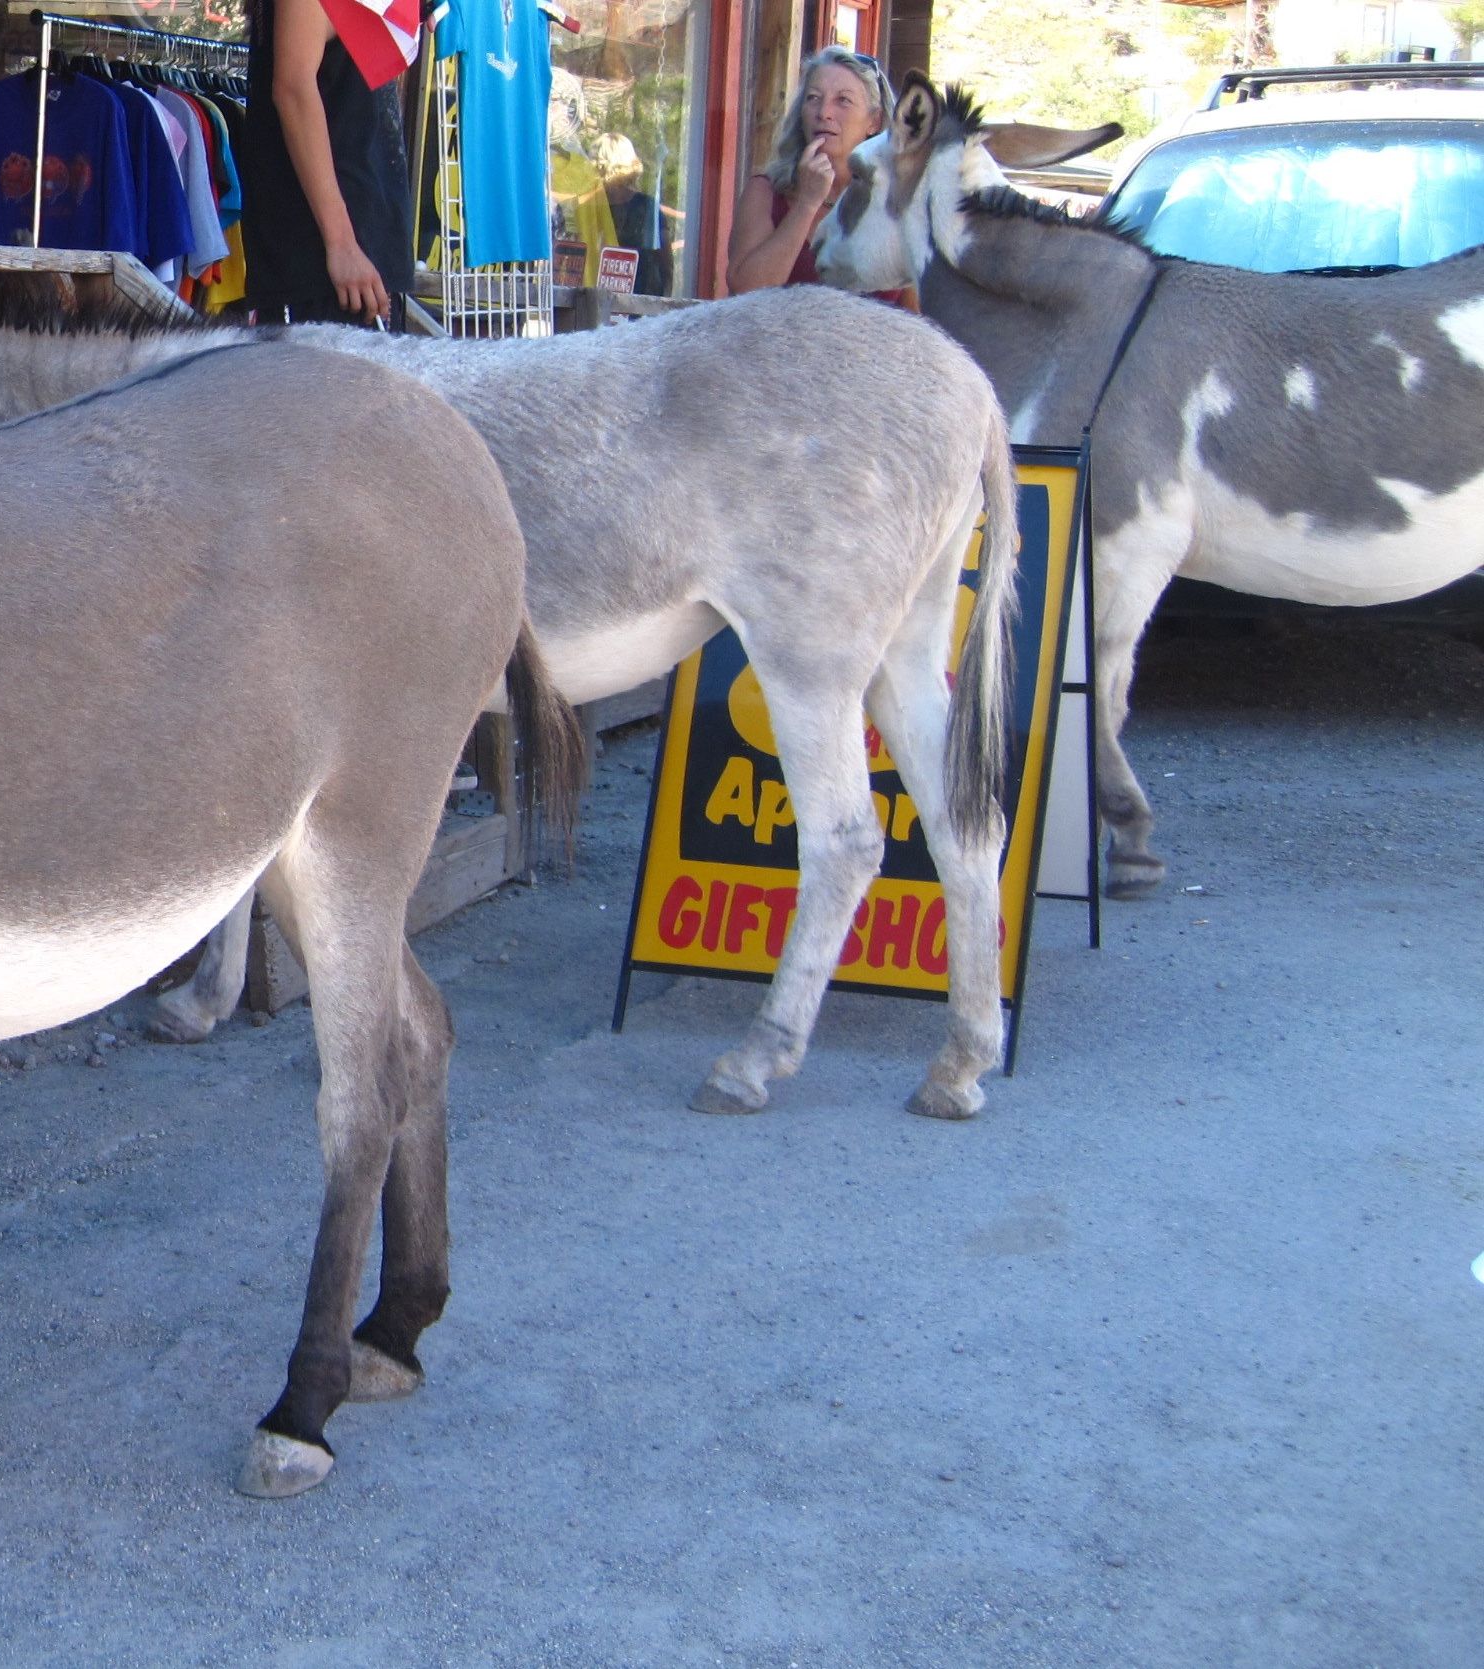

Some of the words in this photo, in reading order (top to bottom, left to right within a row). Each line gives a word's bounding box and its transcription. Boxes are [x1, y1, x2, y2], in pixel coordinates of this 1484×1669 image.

[601, 258, 635, 276] FIREMEN
[599, 275, 632, 292] PARKING
[658, 875, 799, 959] GIFT
